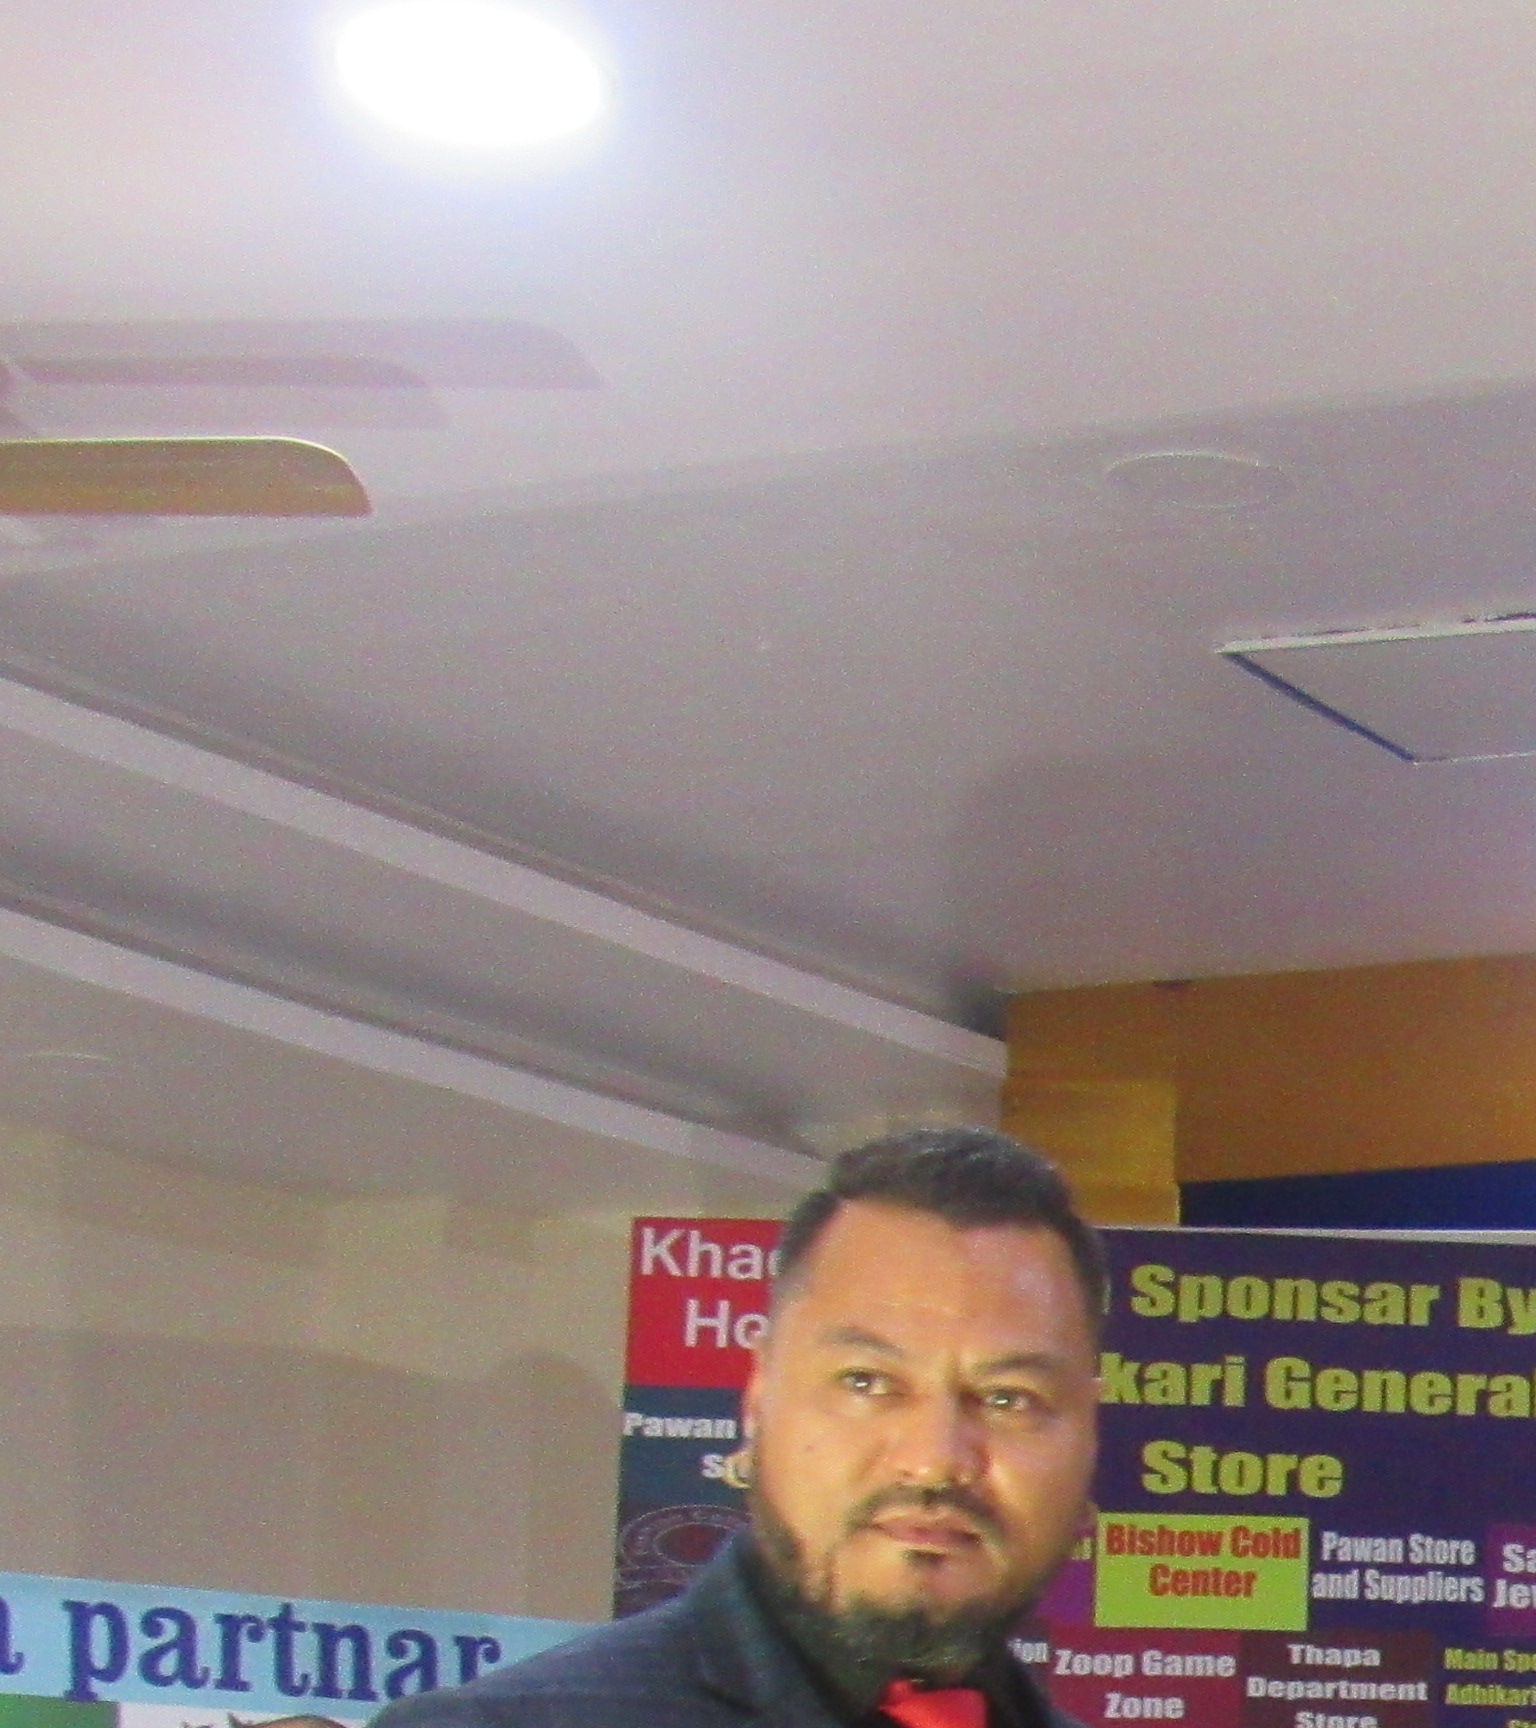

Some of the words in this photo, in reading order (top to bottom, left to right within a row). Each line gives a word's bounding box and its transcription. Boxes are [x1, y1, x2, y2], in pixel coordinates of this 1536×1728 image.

[1131, 1263, 1440, 1326] Sponsar
[623, 1411, 738, 1440] Pawan
[1141, 1440, 1345, 1499] Store
[1105, 1522, 1225, 1557] Bishow
[1230, 1525, 1302, 1559] Cold
[1321, 1530, 1405, 1564] Pawan
[1408, 1533, 1476, 1565] Store
[1149, 1563, 1258, 1597] Center
[1311, 1569, 1360, 1599] and
[1363, 1569, 1486, 1604] Suppliers
[63, 1600, 501, 1702] partnar
[1054, 1648, 1135, 1678] Zoop
[1141, 1649, 1237, 1678] Game
[1287, 1643, 1382, 1668] Thapa
[1444, 1648, 1499, 1671] Main
[1104, 1691, 1186, 1719] Zone
[1246, 1676, 1429, 1701] Department
